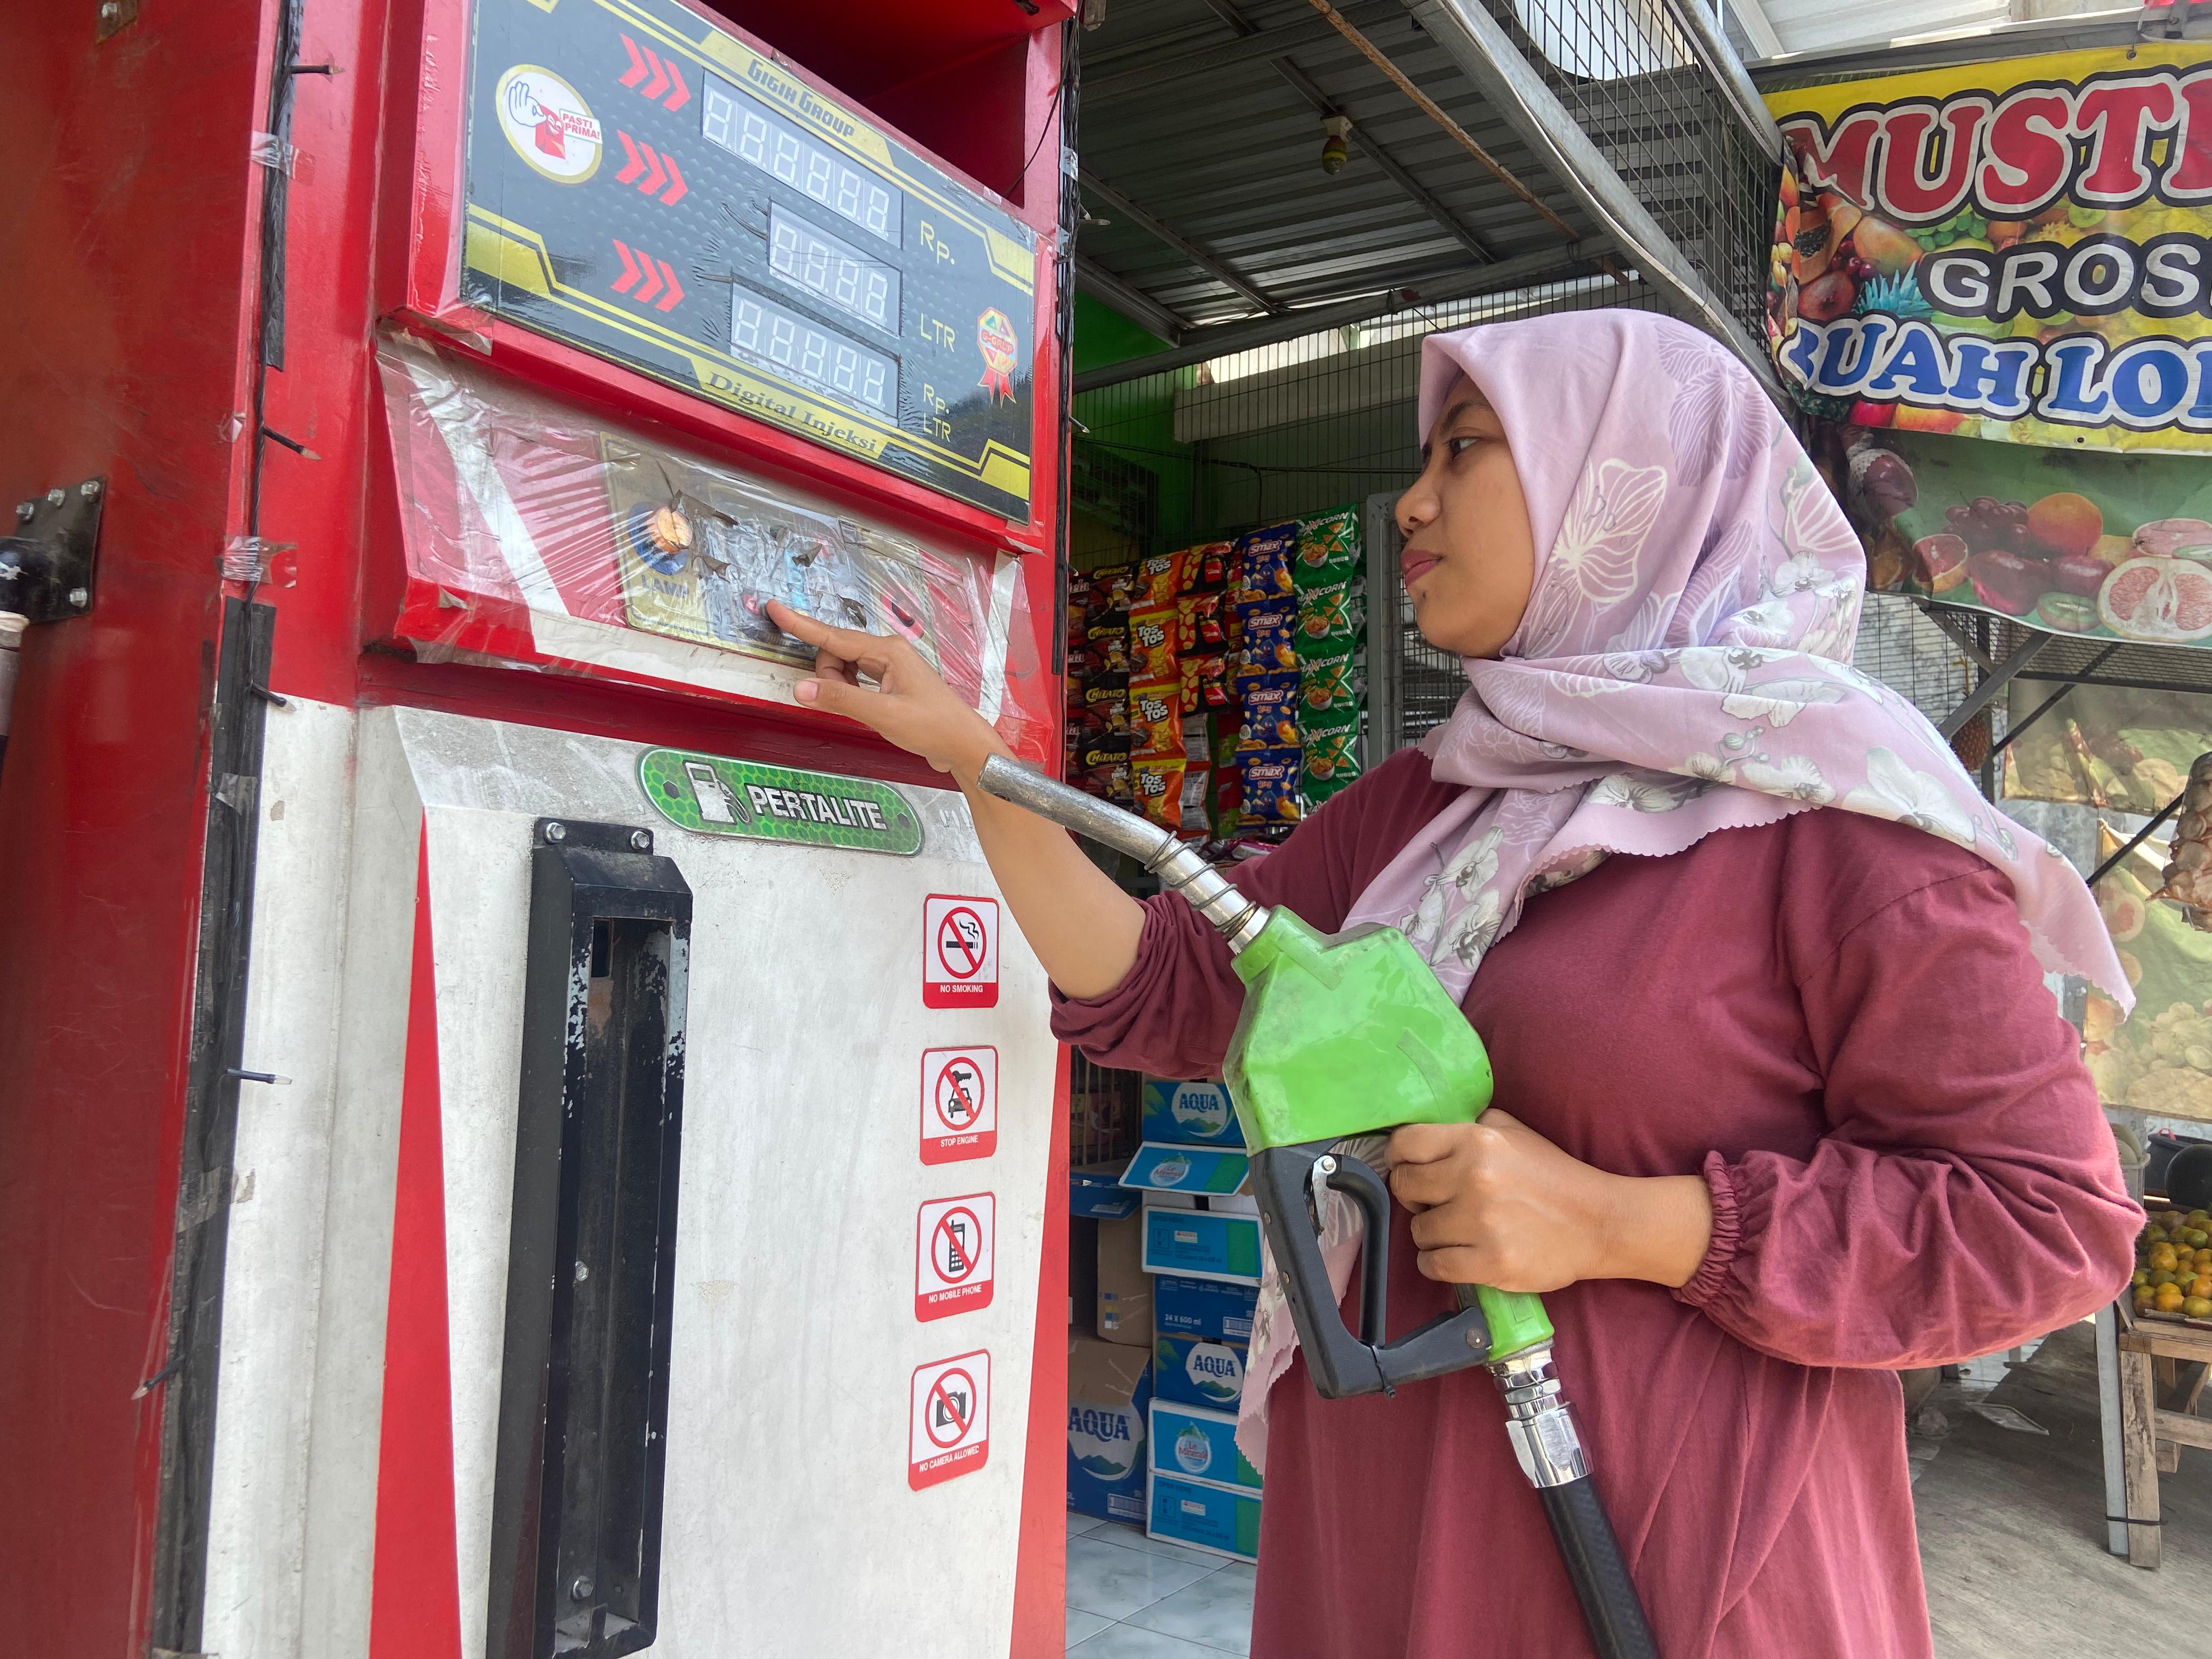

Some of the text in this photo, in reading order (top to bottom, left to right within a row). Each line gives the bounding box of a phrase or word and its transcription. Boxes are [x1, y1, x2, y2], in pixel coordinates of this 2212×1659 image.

[747, 59, 855, 137] GIGIH GROUP
[563, 113, 592, 128] PASTI
[565, 123, 600, 140] PRIMA!
[1930, 243, 2212, 314] GROS
[921, 313, 955, 352] LTR
[706, 372, 877, 452] Digital Injeksi
[923, 413, 951, 442] LTR
[1147, 557, 1166, 567] TOS
[1149, 561, 1171, 575] TOS
[1138, 624, 1159, 637] TOS
[1142, 630, 1165, 647] TOS
[1140, 699, 1162, 712] TOS
[1145, 705, 1168, 722] TOS
[1140, 773, 1162, 785] TOS
[1143, 781, 1166, 795] TOS
[745, 783, 887, 830] PERTALITE
[1179, 1093, 1219, 1113] AQUA
[941, 1135, 978, 1147] STOP ENGINE
[929, 1284, 981, 1304] NO MOBILE PHONE
[1193, 1355, 1235, 1377] AQUA
[1068, 1407, 1130, 1442] AQUA
[919, 1445, 979, 1472] NO CAMERA ALLOWED
